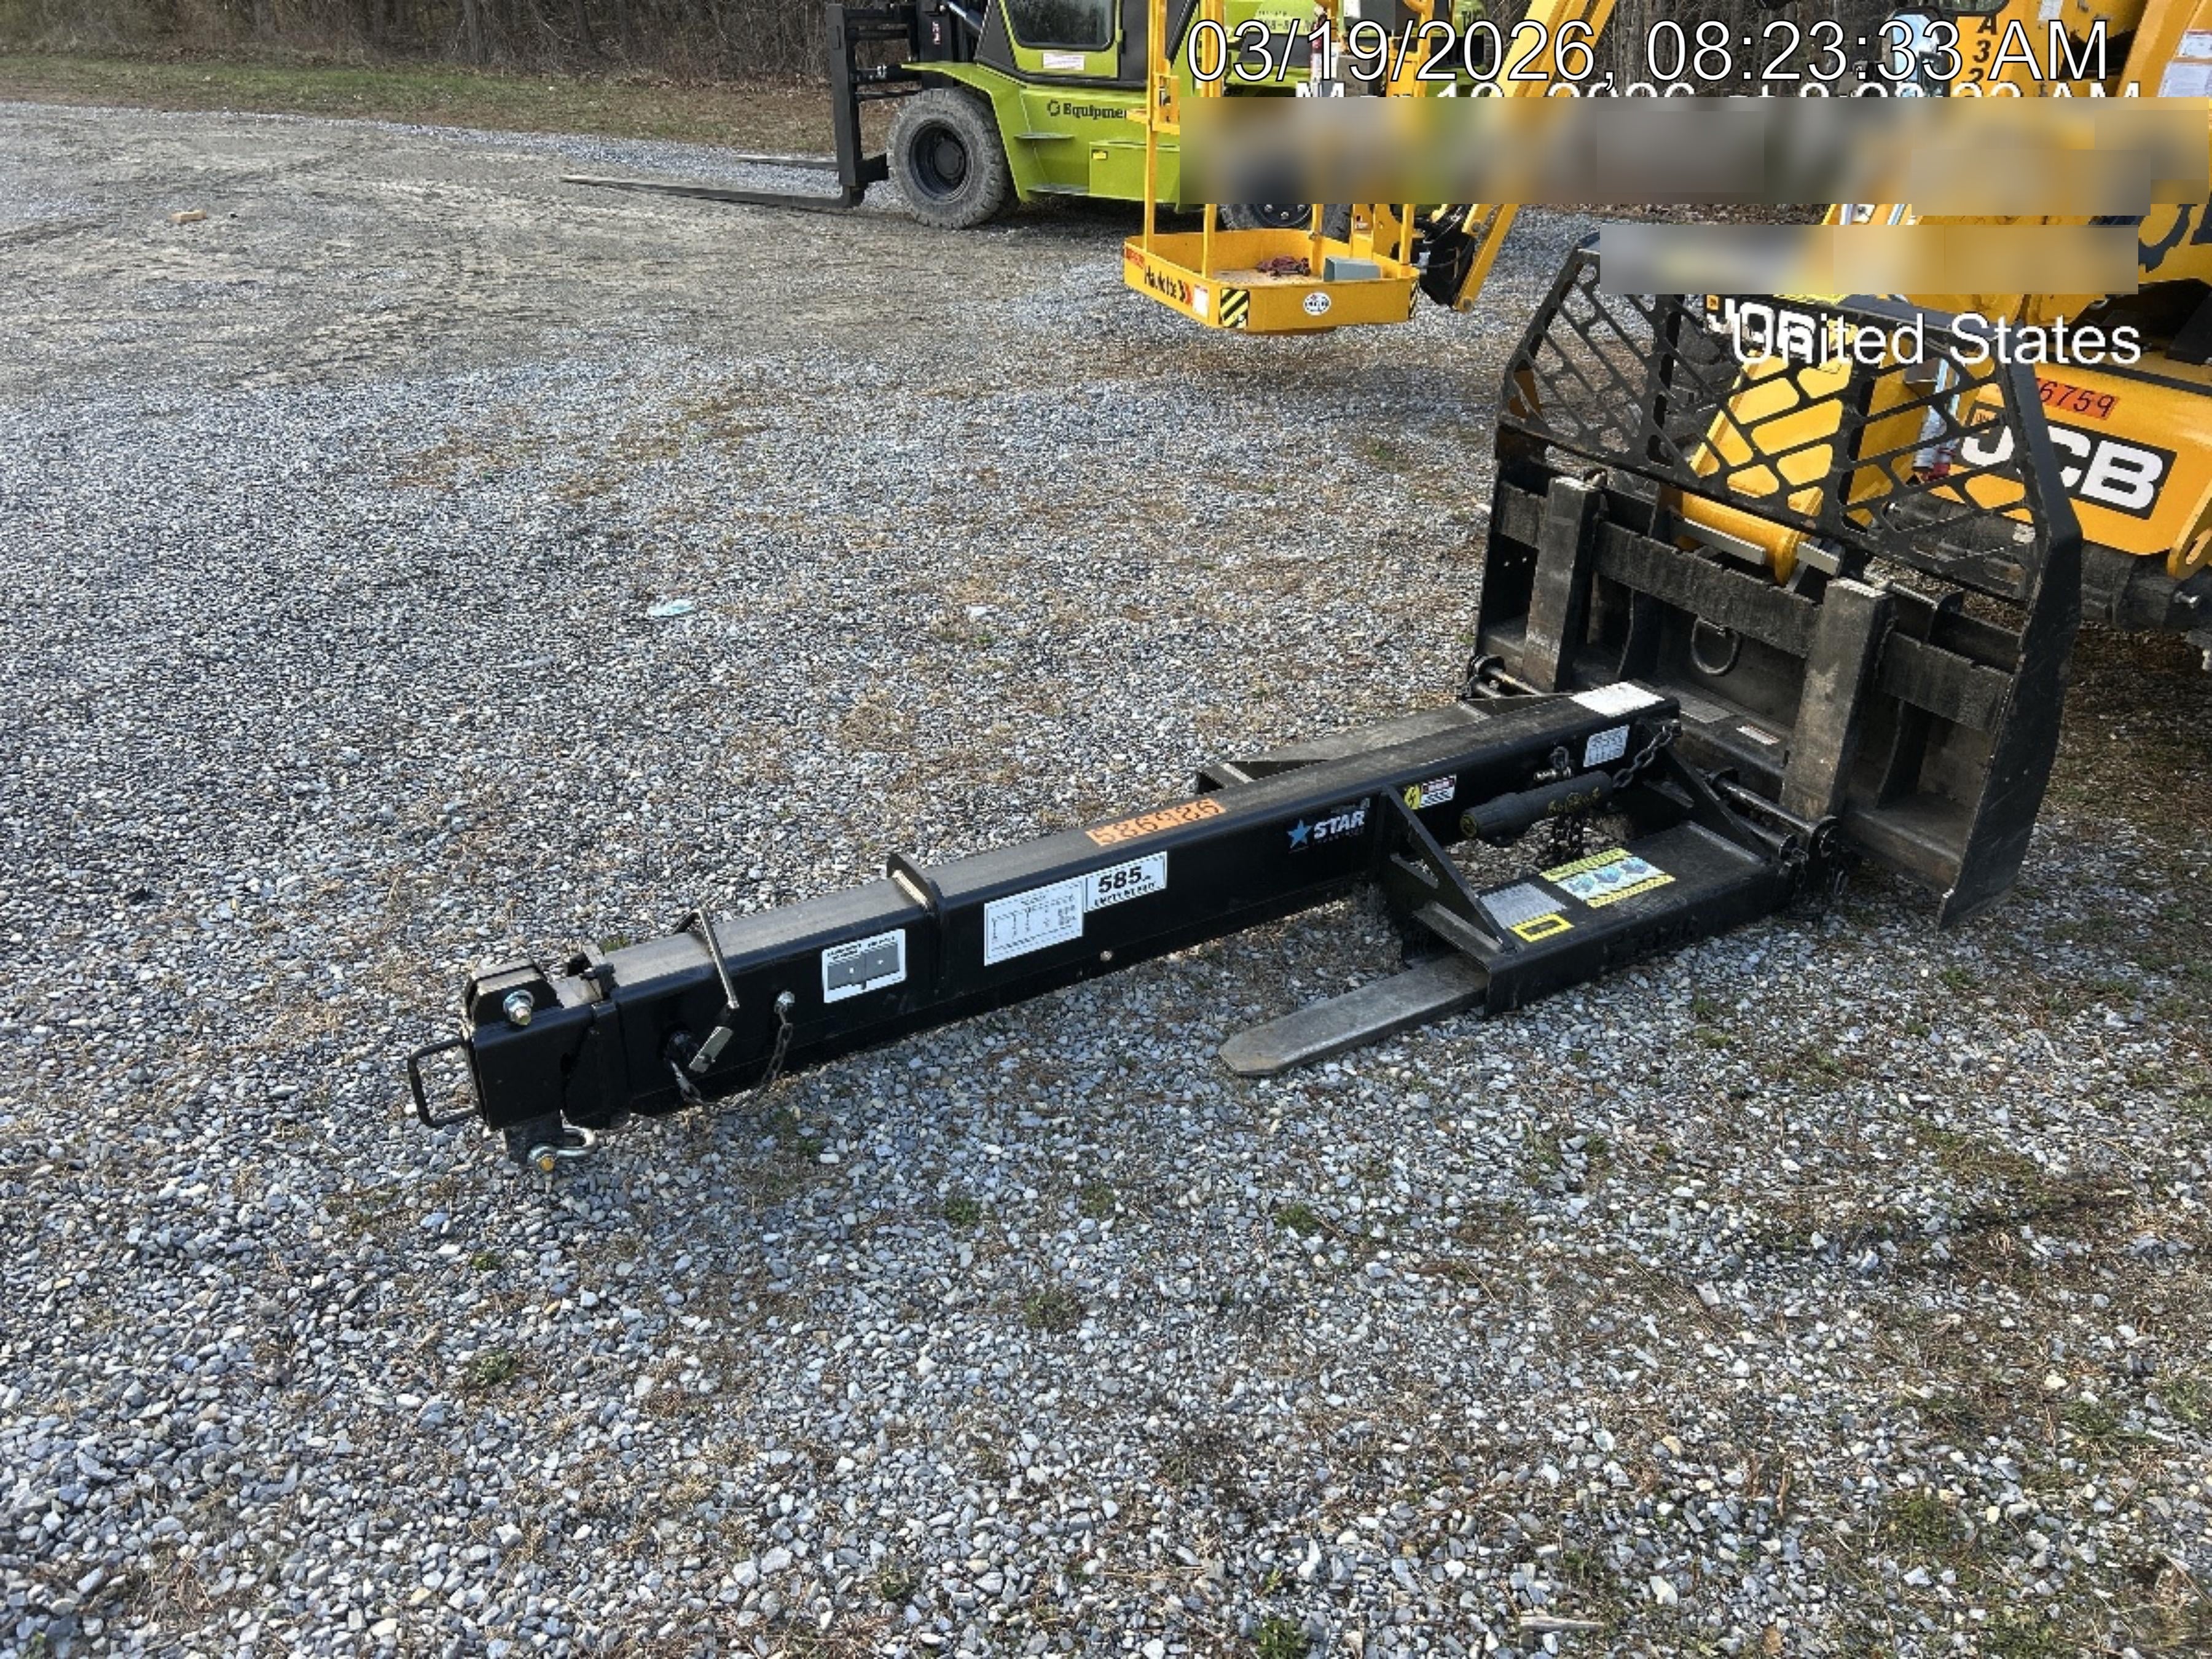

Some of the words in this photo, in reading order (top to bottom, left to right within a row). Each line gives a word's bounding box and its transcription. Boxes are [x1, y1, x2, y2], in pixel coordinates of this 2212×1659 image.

[2036, 377, 2115, 417] 6759
[1960, 424, 2163, 510] JCB
[1313, 810, 1365, 840] STAR
[1098, 865, 1142, 893] 585
